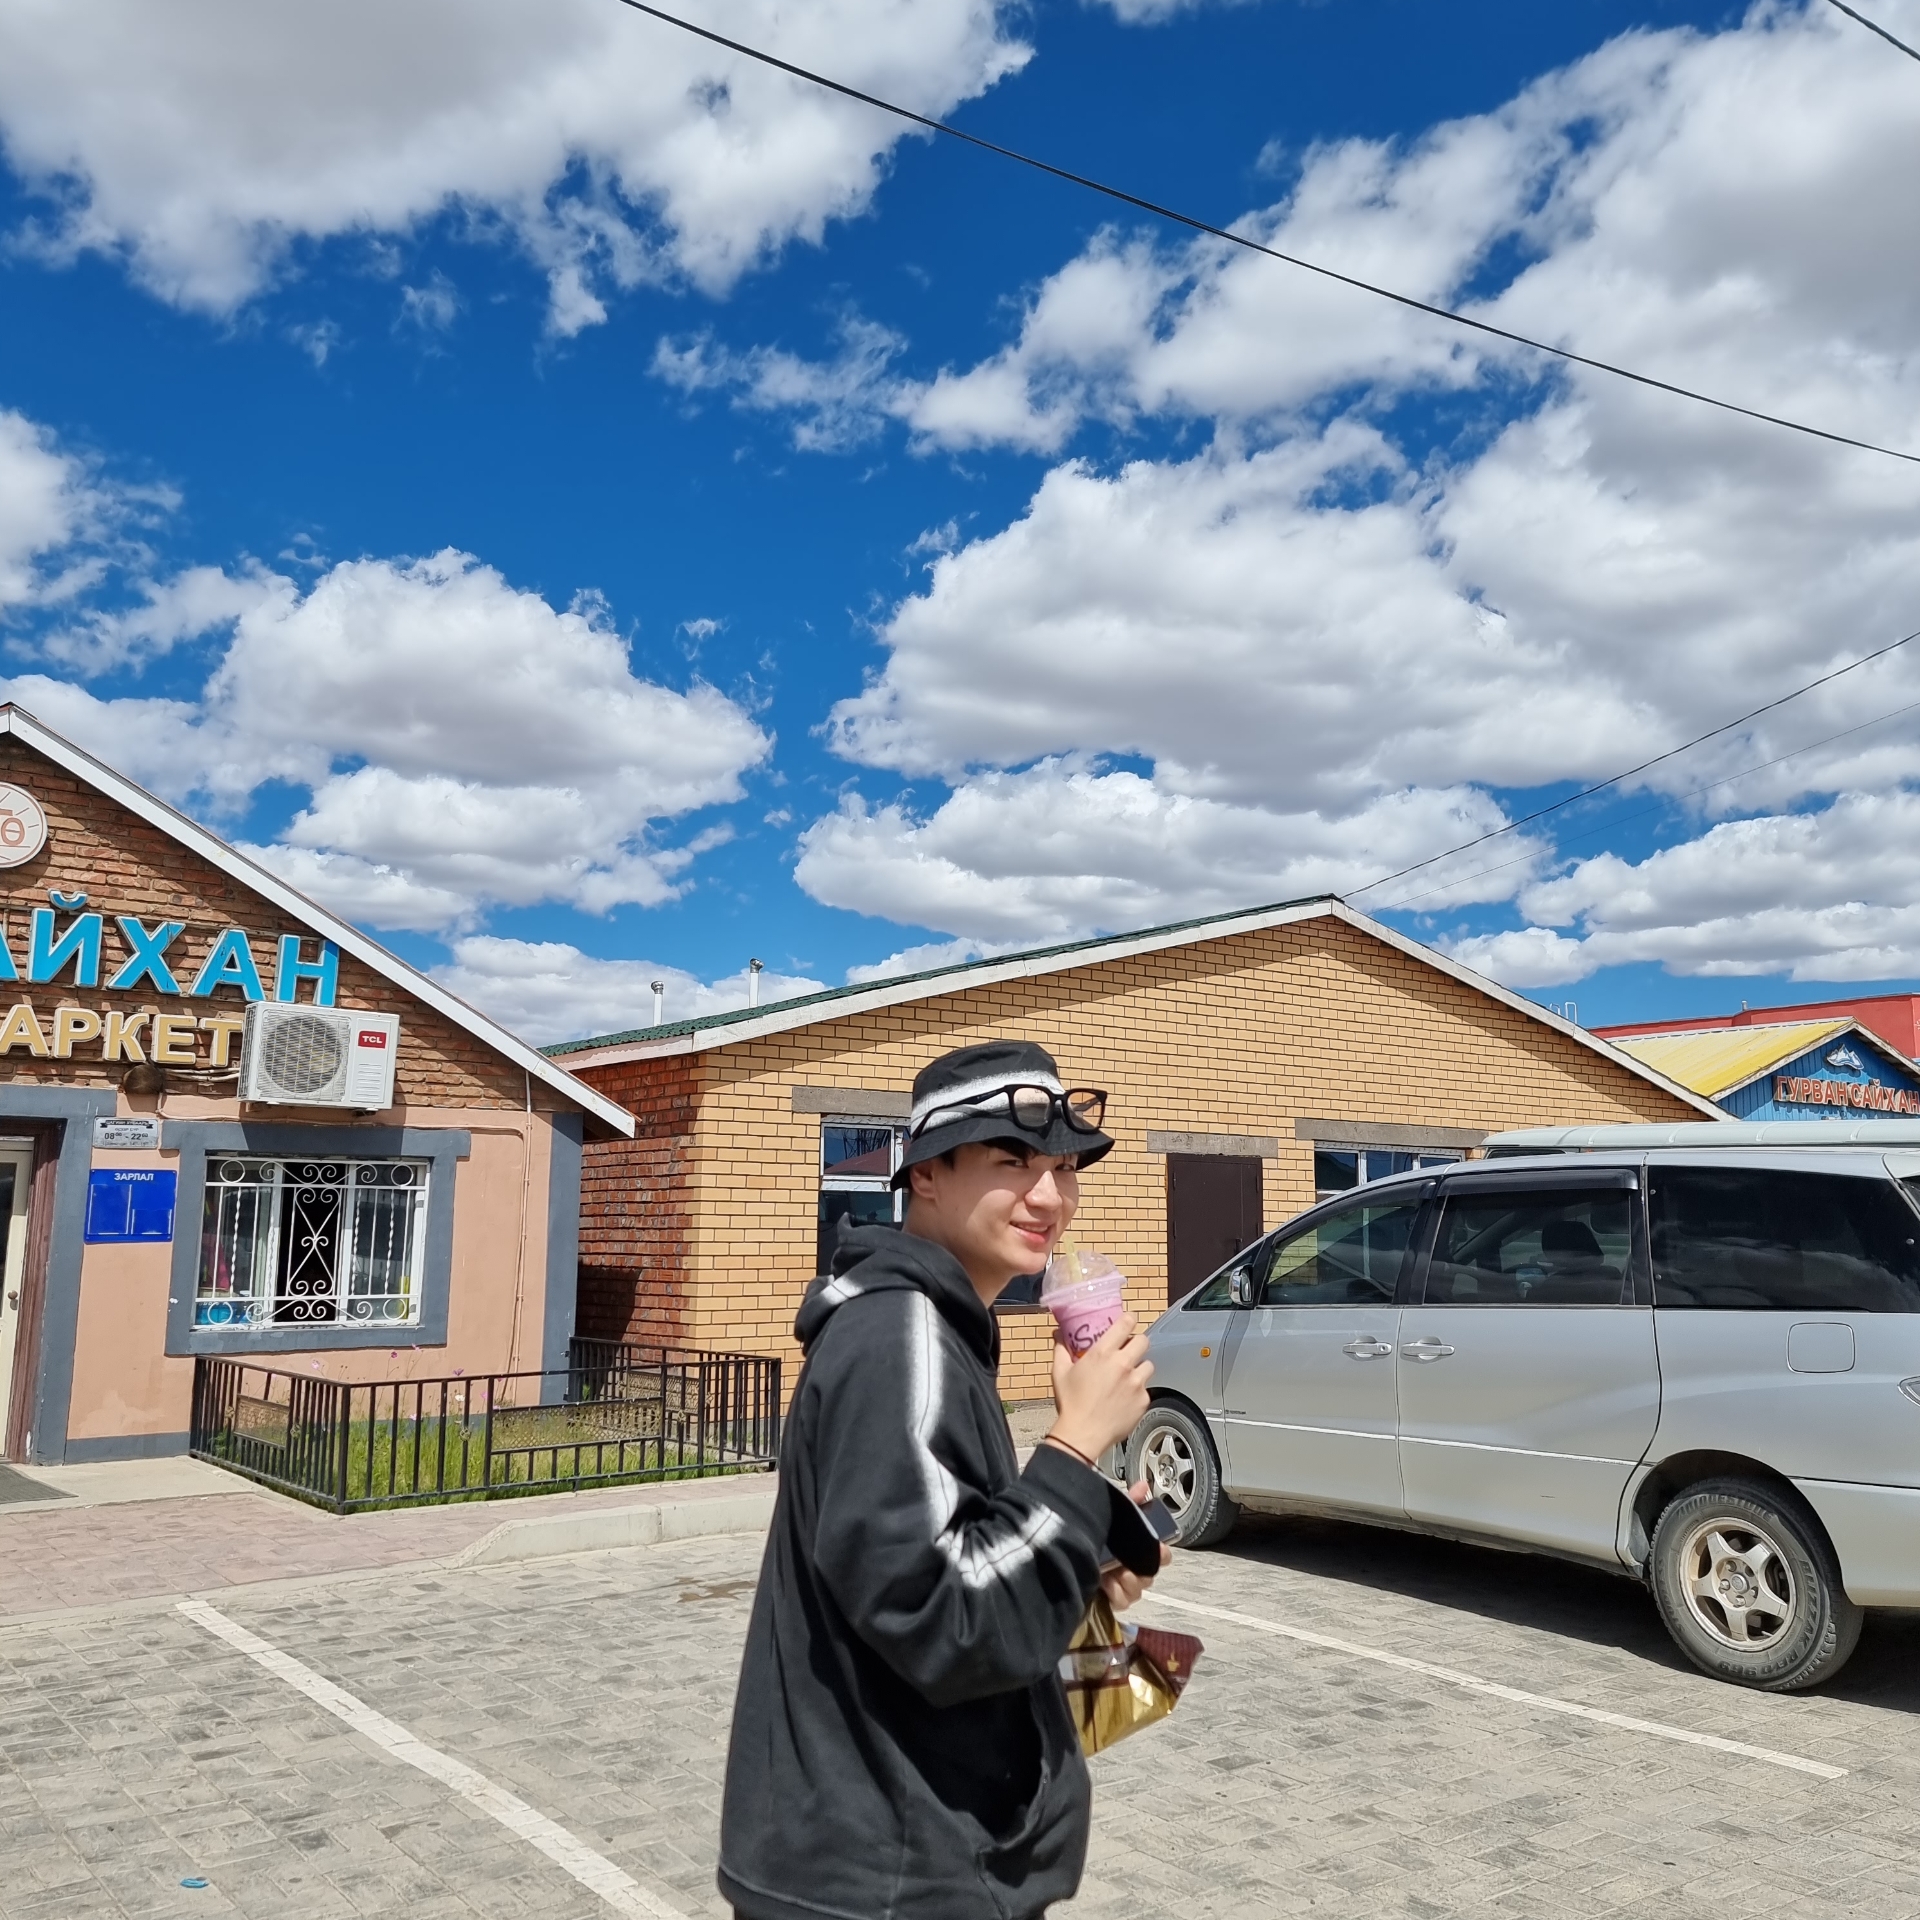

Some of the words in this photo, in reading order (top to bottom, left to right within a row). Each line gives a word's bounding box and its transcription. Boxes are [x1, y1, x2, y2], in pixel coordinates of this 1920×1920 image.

[0, 1004, 243, 1067] АРКЕТ
[362, 1035, 383, 1044] TCL
[1776, 1076, 1849, 1106] ГУРВАН
[1850, 1079, 1920, 1114] САЙХАН
[114, 1172, 154, 1181] ЗАРЛАЛ
